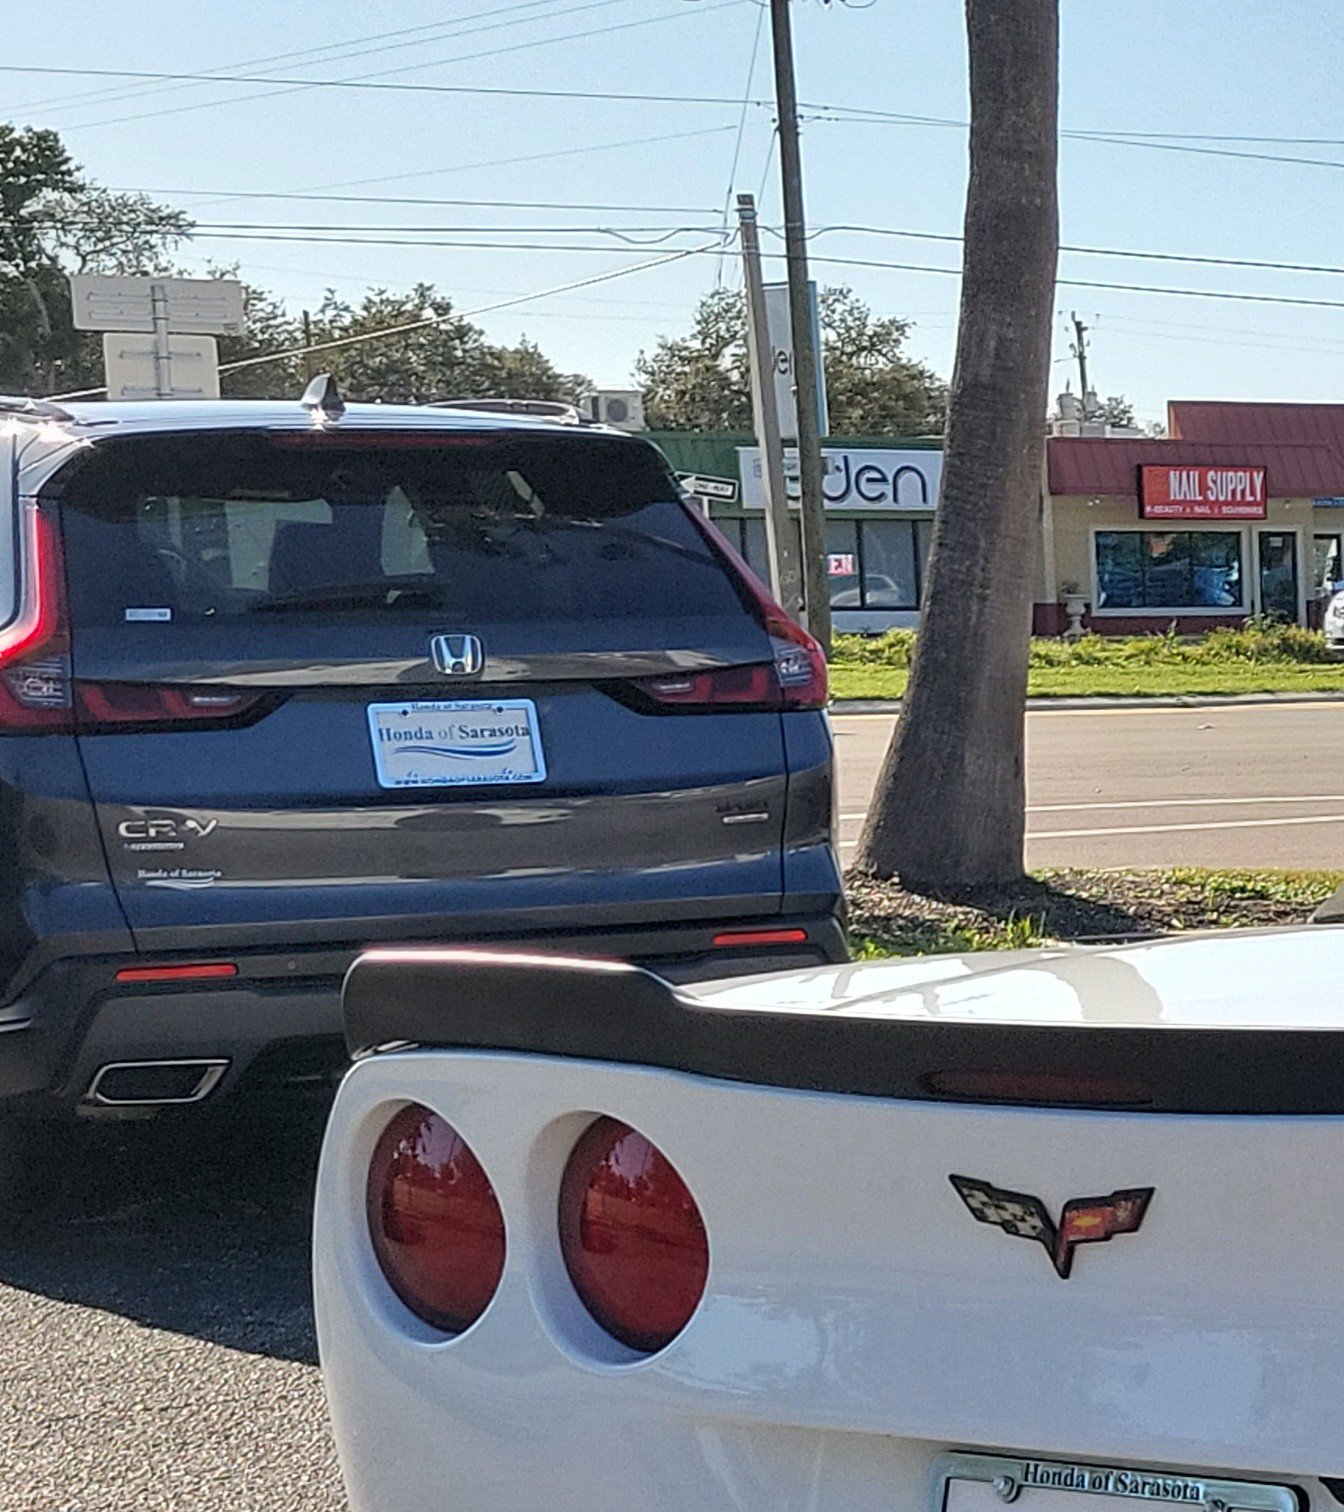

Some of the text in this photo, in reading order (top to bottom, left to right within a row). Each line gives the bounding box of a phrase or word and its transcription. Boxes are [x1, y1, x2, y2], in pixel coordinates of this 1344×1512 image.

[785, 454, 928, 504] den
[1169, 470, 1265, 502] NAIL SUPPLY
[378, 724, 530, 742] Honda of Sarasota
[1023, 1462, 1201, 1502] Honda of Sarasota
